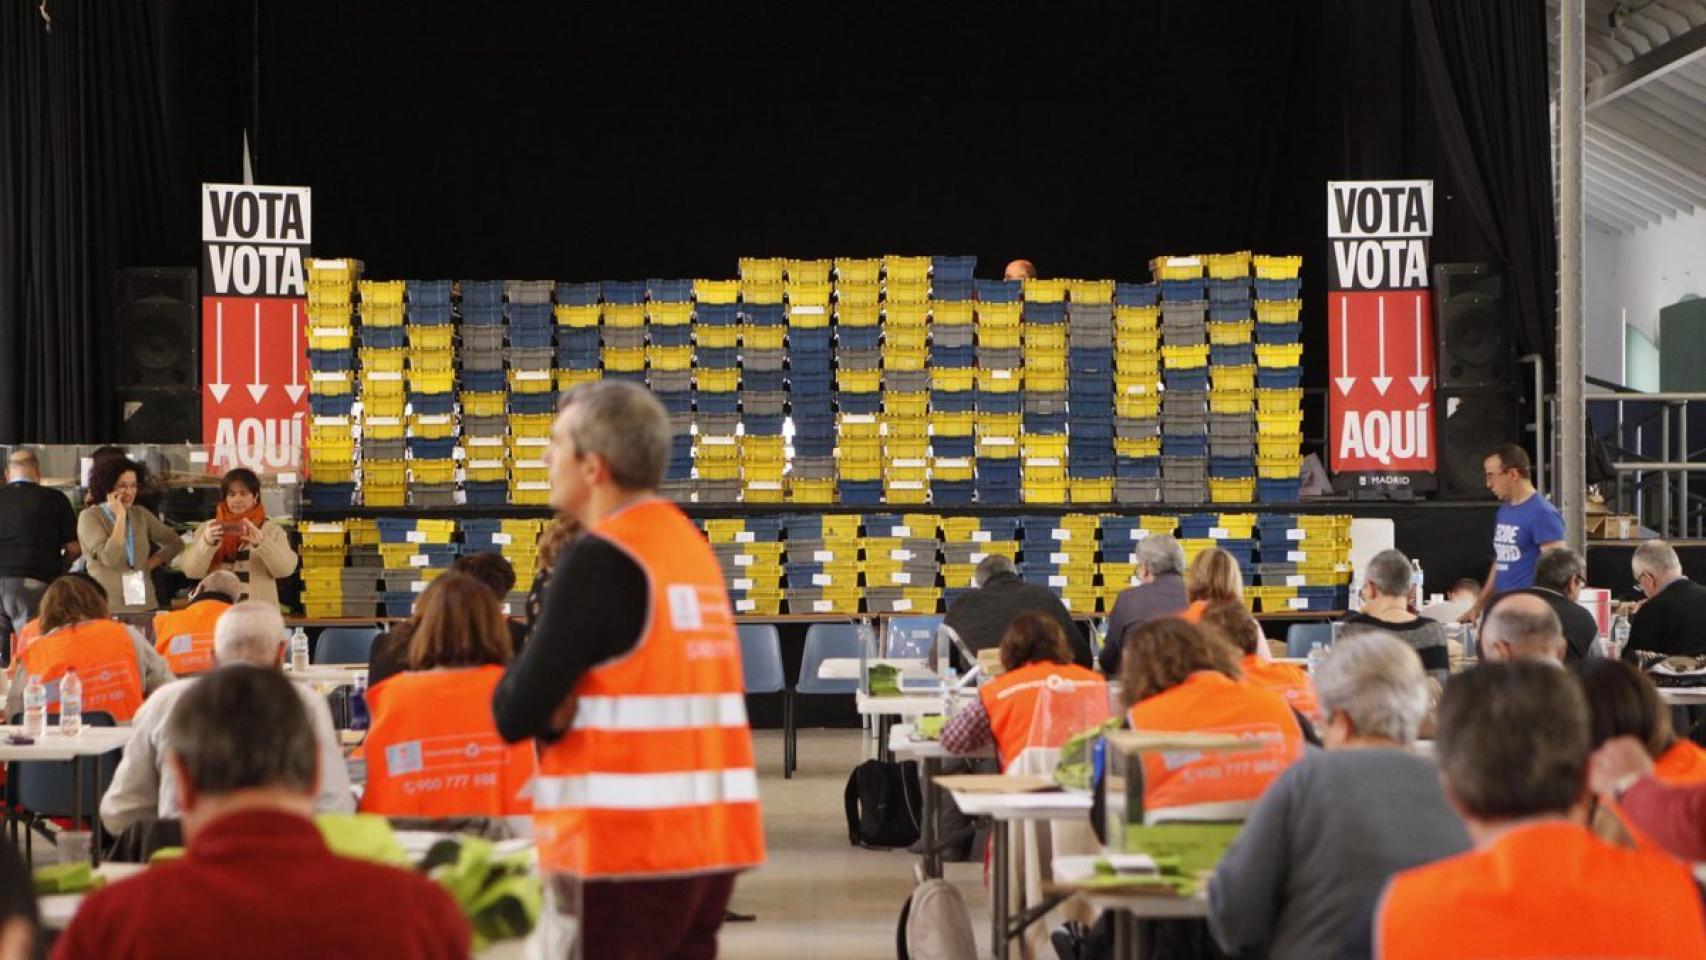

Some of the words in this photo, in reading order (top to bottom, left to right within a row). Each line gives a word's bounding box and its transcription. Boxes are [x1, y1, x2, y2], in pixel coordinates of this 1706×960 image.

[209, 190, 305, 241] VOTA
[1334, 186, 1428, 234] VOTA
[208, 243, 305, 296] VOTA
[1333, 239, 1429, 290] VOTA
[211, 411, 305, 471] AQUÍ
[1339, 402, 1431, 466] AQUÍ
[1371, 475, 1410, 485] MADRID
